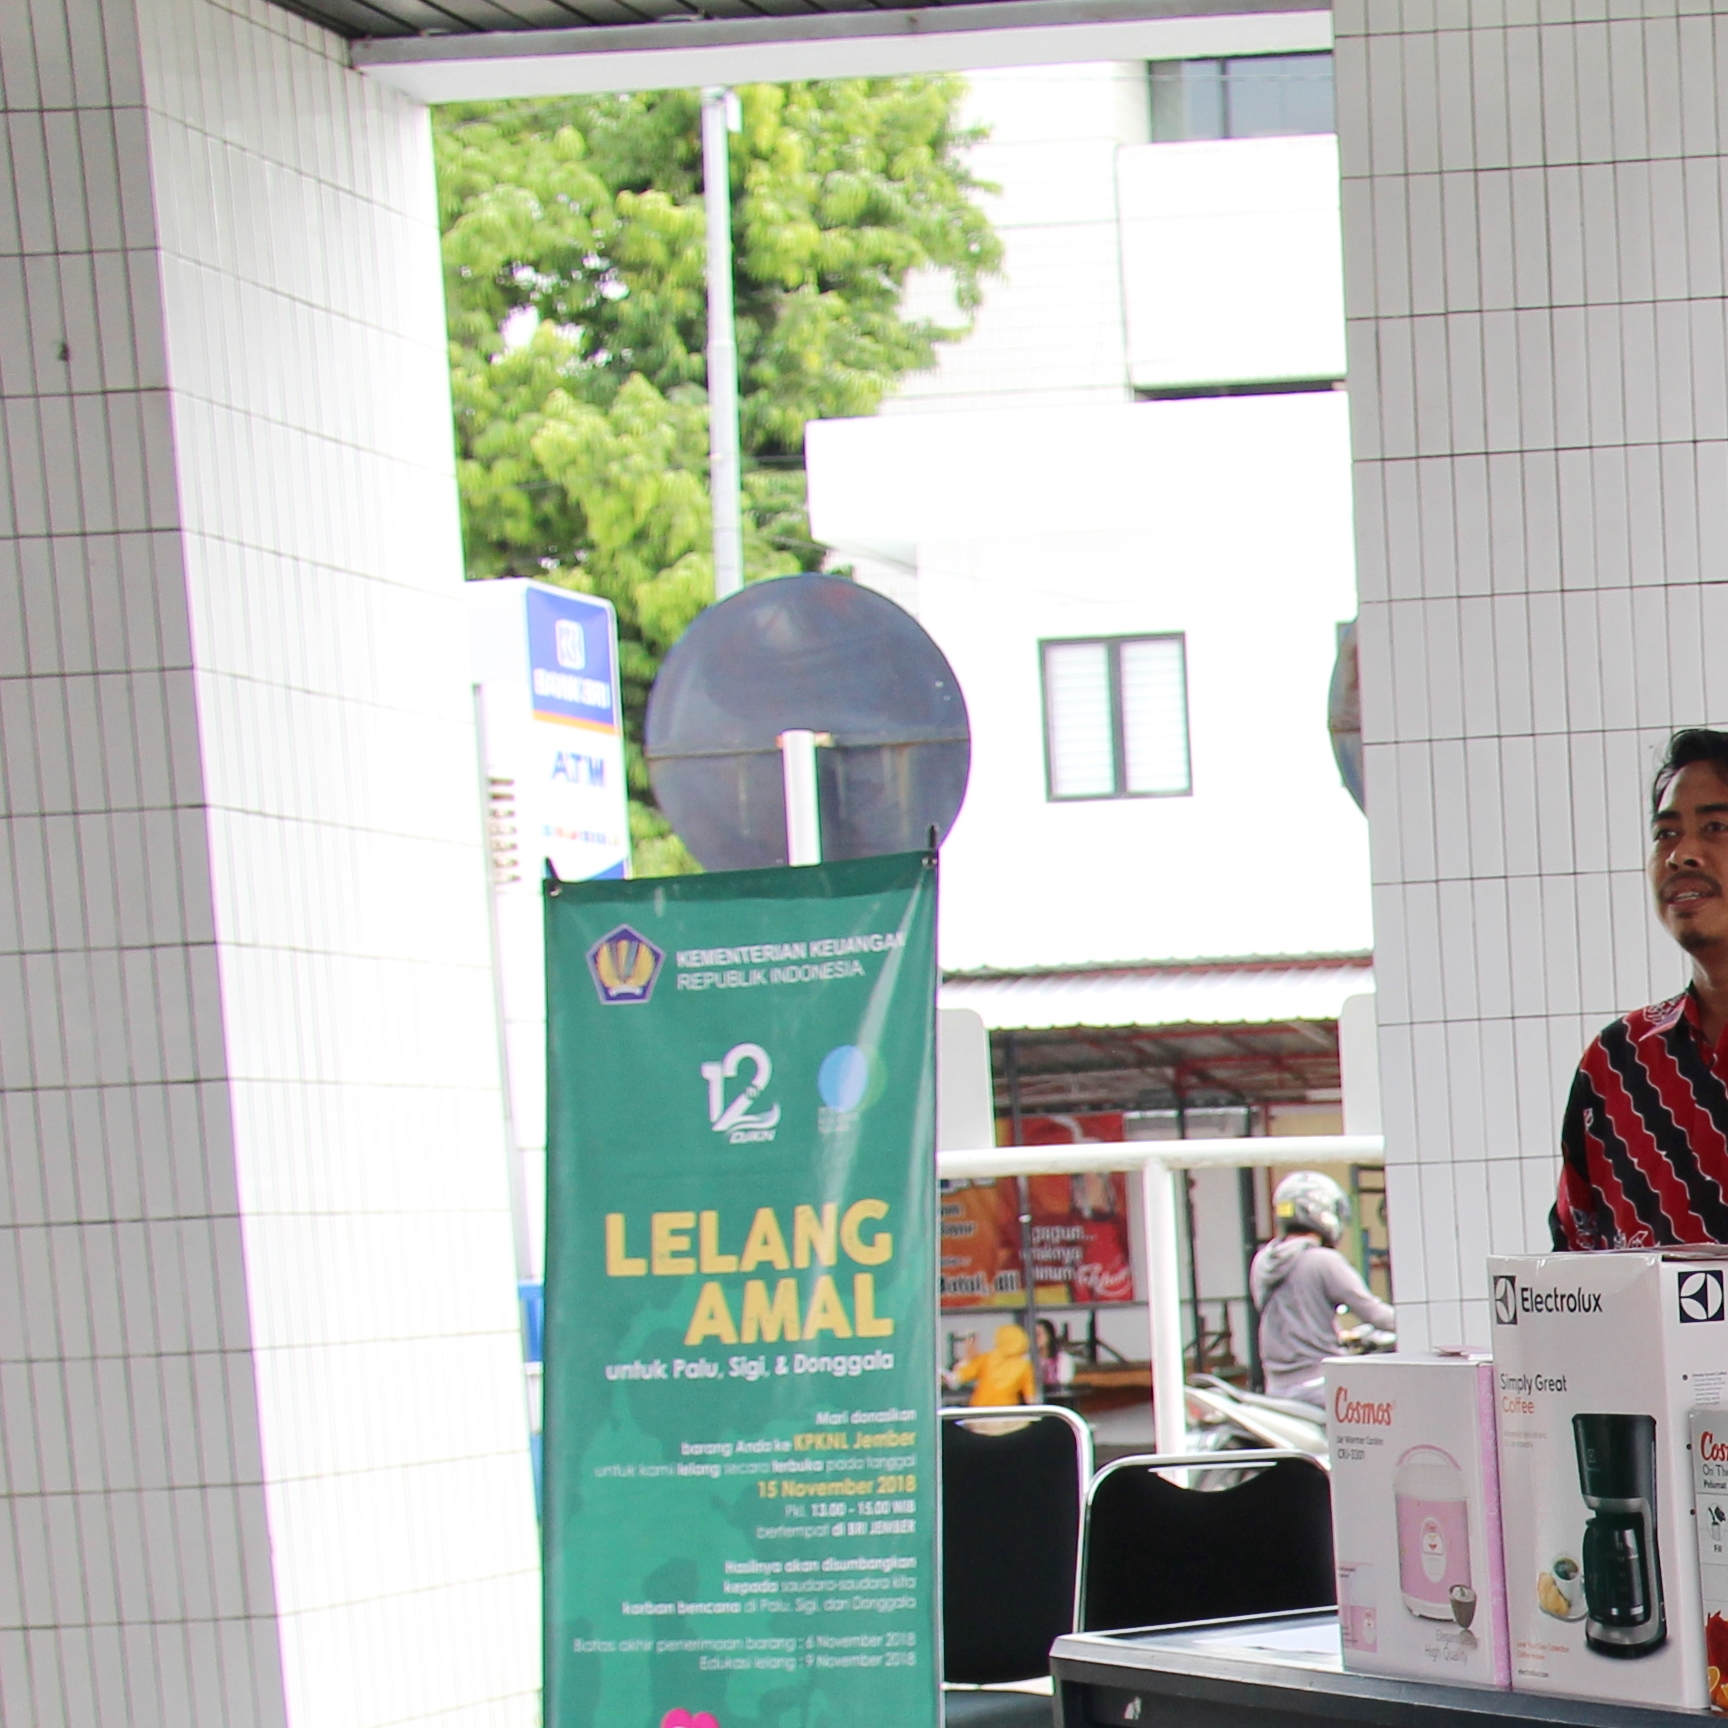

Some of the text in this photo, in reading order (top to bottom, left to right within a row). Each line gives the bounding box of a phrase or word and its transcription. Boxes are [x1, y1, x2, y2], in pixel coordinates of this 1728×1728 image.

[676, 941, 807, 968] KEMENTERIAN
[676, 959, 865, 991] REPUBLIK INDONESIA
[605, 1199, 894, 1278] LELANG
[684, 1273, 894, 1346] AMAL
[1520, 1286, 1603, 1314] Electrolux
[605, 1358, 669, 1381] untuk
[673, 1356, 725, 1379] Palu,
[728, 1354, 771, 1380] Sigi,
[794, 1350, 894, 1379] Donggala
[1500, 1373, 1568, 1395] Simply Great
[850, 1408, 917, 1424] donasikan
[1334, 1386, 1393, 1426] Cosmos
[1502, 1396, 1535, 1415] Coffee
[793, 1432, 848, 1452] KPKNL
[853, 1430, 917, 1449] Jember
[757, 1474, 917, 1499] 15 November 2018
